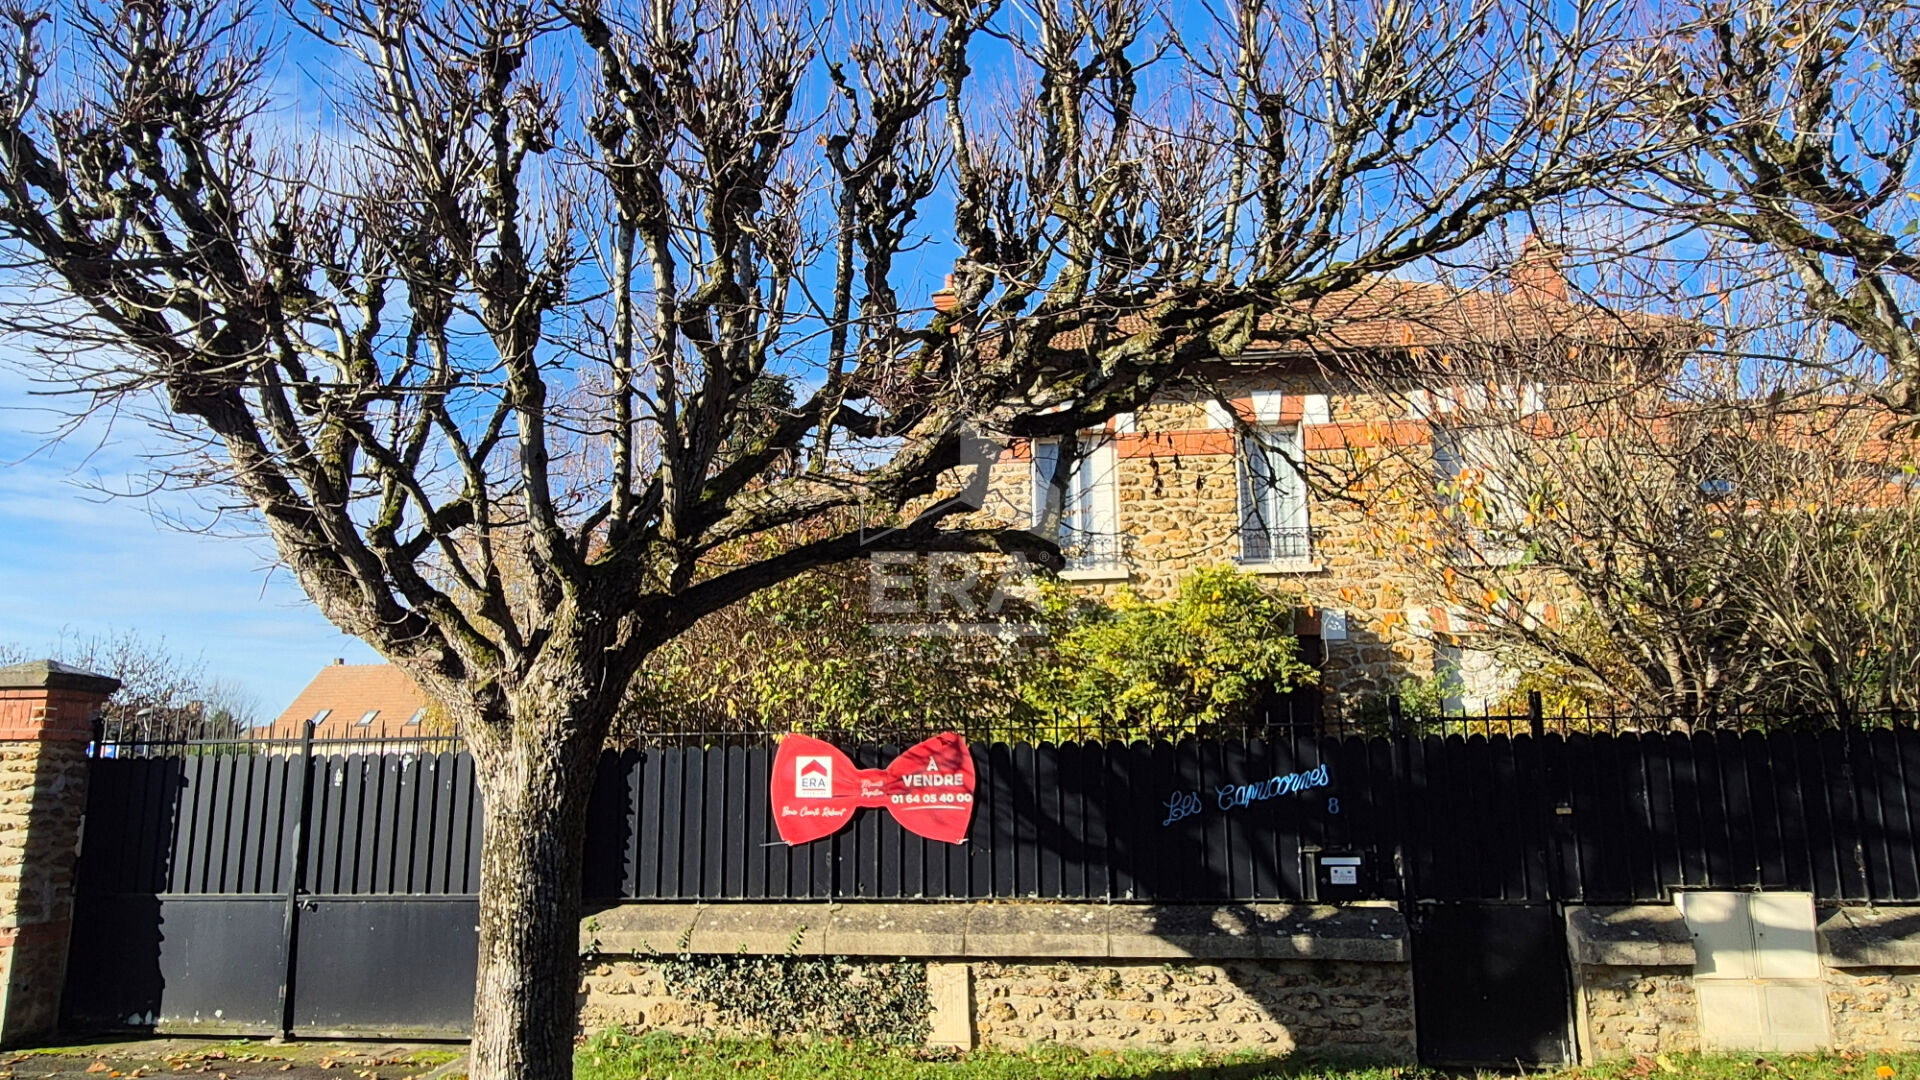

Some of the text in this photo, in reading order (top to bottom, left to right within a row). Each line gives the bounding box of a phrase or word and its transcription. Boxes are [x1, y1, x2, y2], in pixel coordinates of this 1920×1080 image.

[926, 756, 939, 772] À
[801, 778, 826, 787] ERA
[902, 773, 964, 787] VENDRE
[891, 792, 973, 804] 01 64 05 40 00
[1162, 763, 1329, 826] Les Capricornes
[1328, 797, 1340, 815] 8
